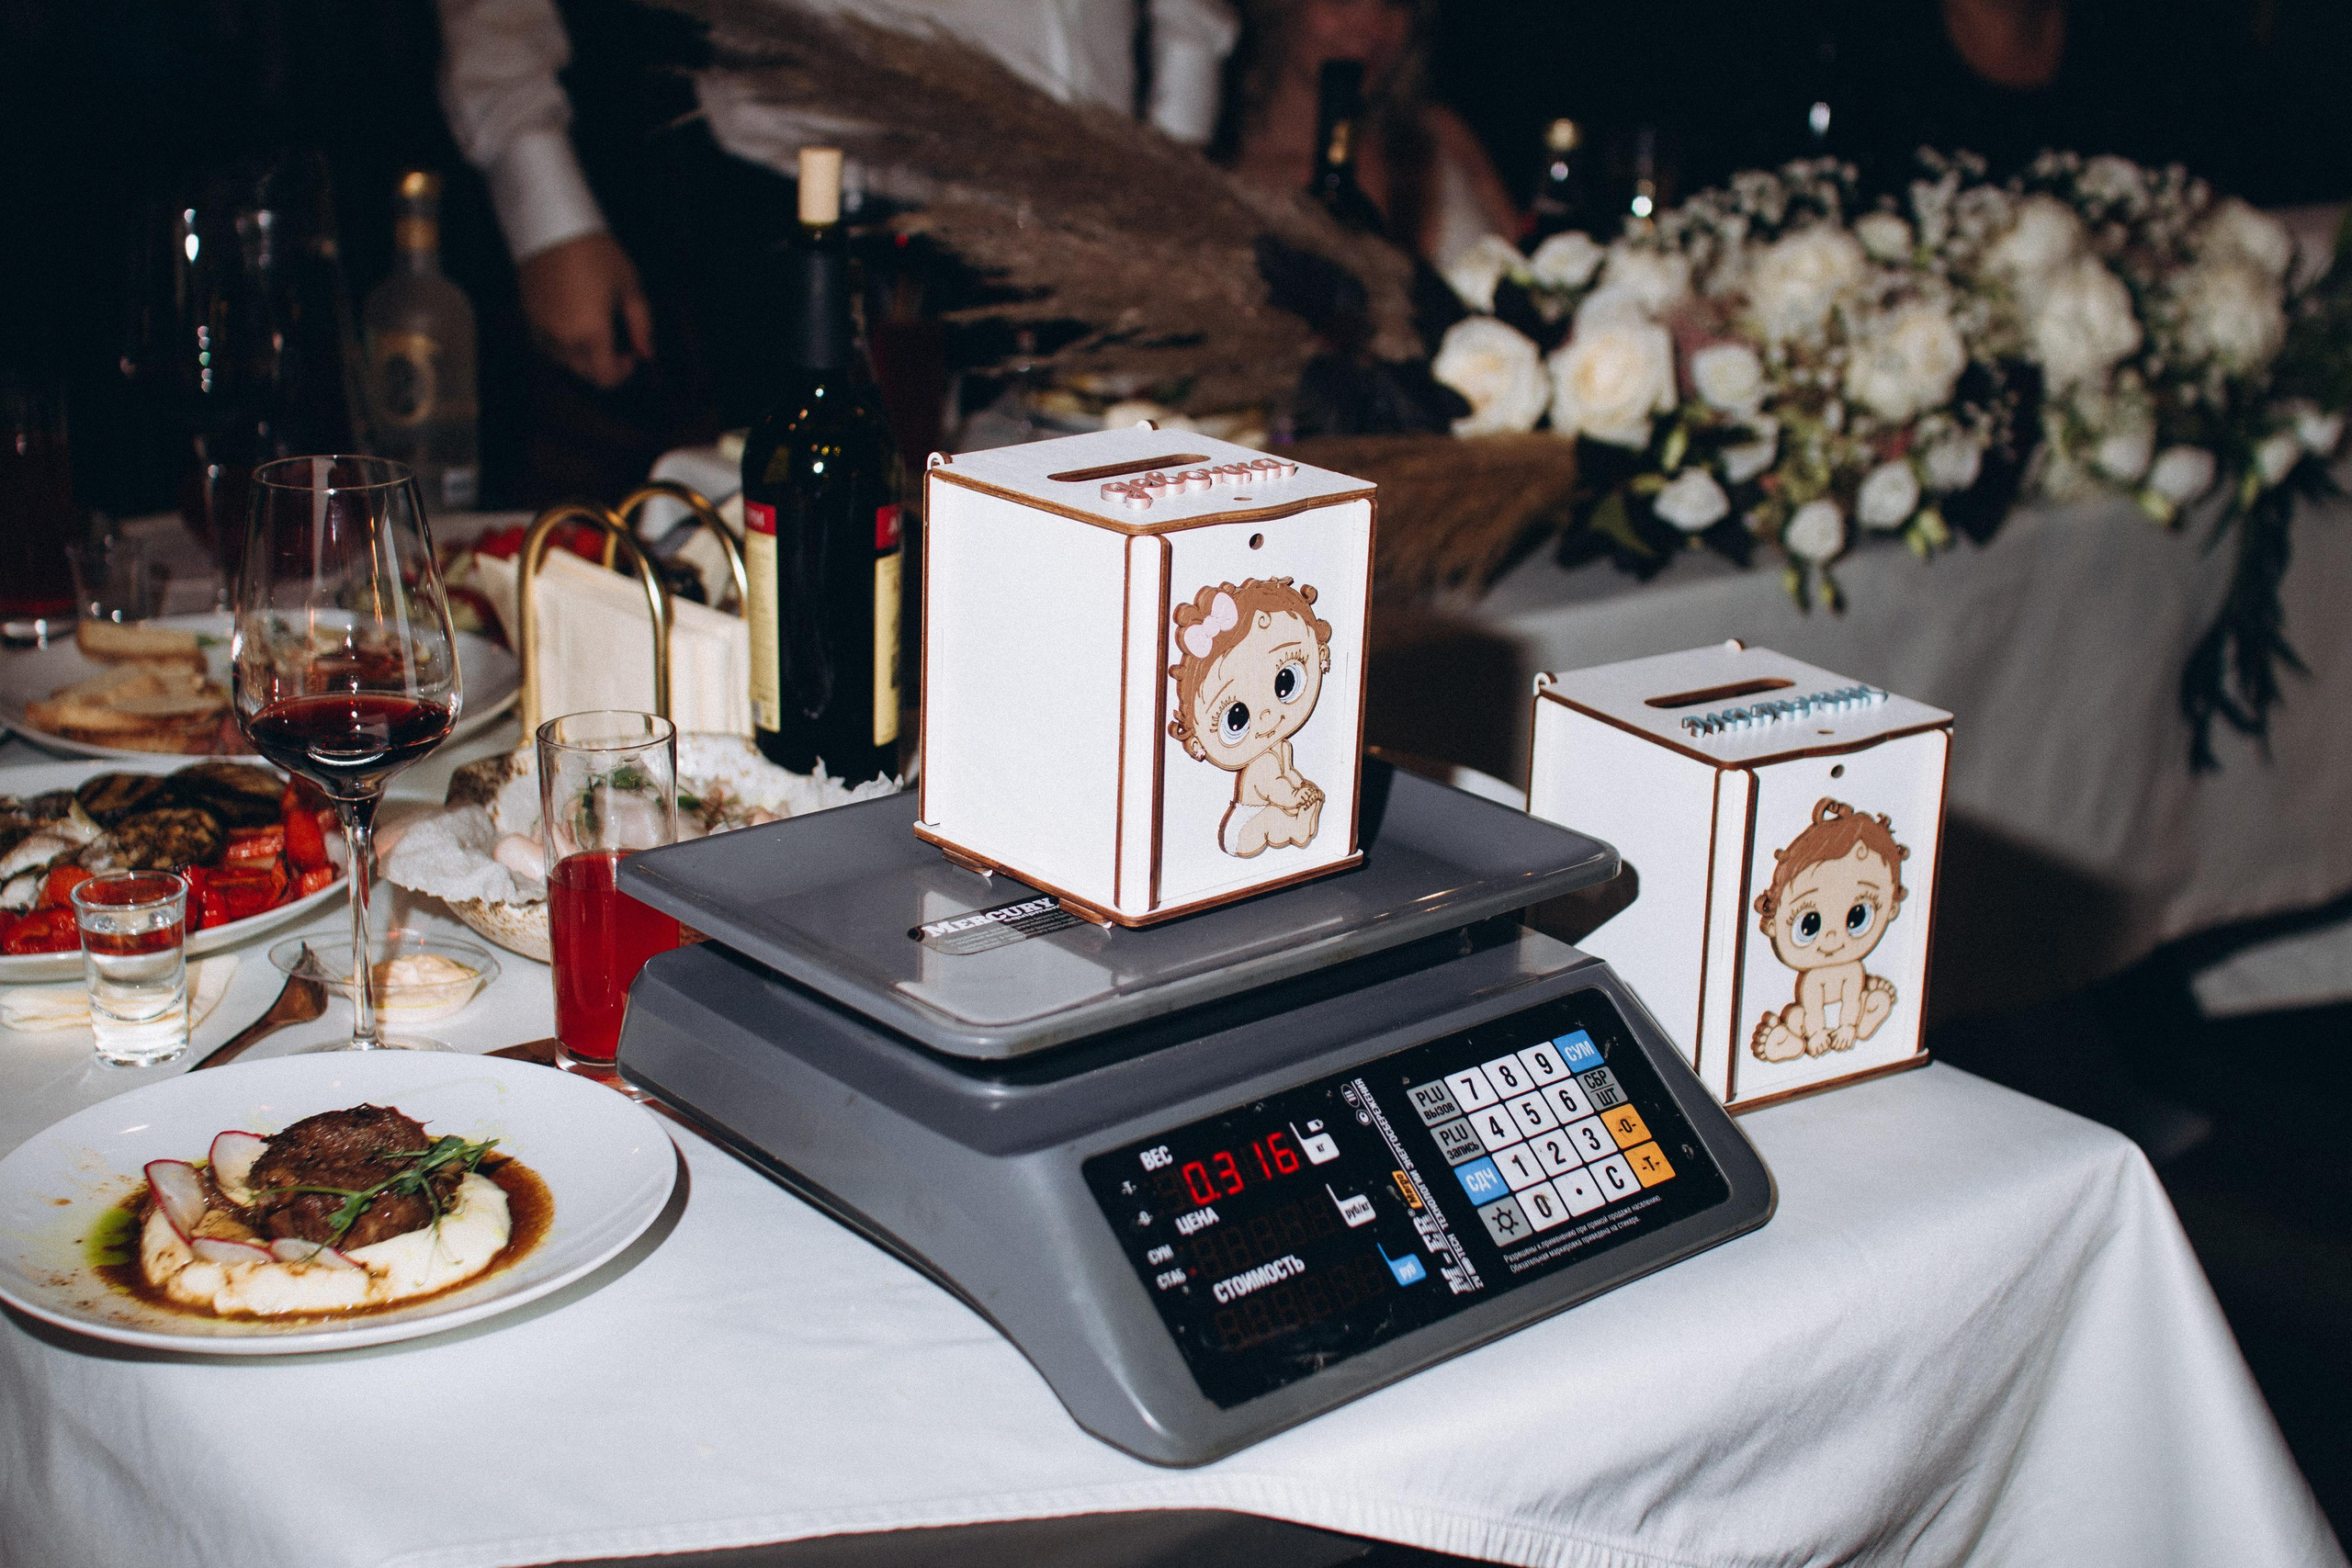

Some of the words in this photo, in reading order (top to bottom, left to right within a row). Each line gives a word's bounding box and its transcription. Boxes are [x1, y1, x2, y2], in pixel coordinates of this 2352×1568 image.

[922, 897, 1052, 938] MERCURY
[1564, 1040, 1594, 1063] СУМ
[1534, 1052, 1554, 1075] 9
[1498, 1065, 1517, 1088] 8
[1587, 1069, 1608, 1090] СБР
[1415, 1085, 1445, 1107] PLU
[1461, 1077, 1479, 1100] 7
[1595, 1088, 1616, 1107] ШТ
[1424, 1101, 1455, 1120] вызов
[1558, 1089, 1577, 1112] 6
[1354, 1077, 1415, 1171] ЭНЕРГОСБЕРЕЖЕНИЯ
[1521, 1102, 1542, 1125] 5
[1439, 1123, 1468, 1146] PLU
[1488, 1116, 1505, 1138] 4
[1581, 1127, 1601, 1150] 3
[1139, 1145, 1172, 1171] ВЕС
[1316, 1144, 1326, 1153] кг
[1446, 1141, 1480, 1160] запись
[1546, 1141, 1566, 1165] 2
[1511, 1155, 1529, 1177] 1
[1397, 1173, 1418, 1204] Margo
[1465, 1168, 1498, 1193] СДЧ
[1345, 1201, 1370, 1219] руб/кг
[1409, 1170, 1449, 1231] ТЕХНОЛОГИИ
[1533, 1193, 1552, 1219] 0
[1175, 1207, 1220, 1235] ЦЕНА
[1148, 1244, 1173, 1265] СУМ
[1156, 1268, 1186, 1290] СТАБ
[1213, 1255, 1306, 1303] СТОИМОСТЬ
